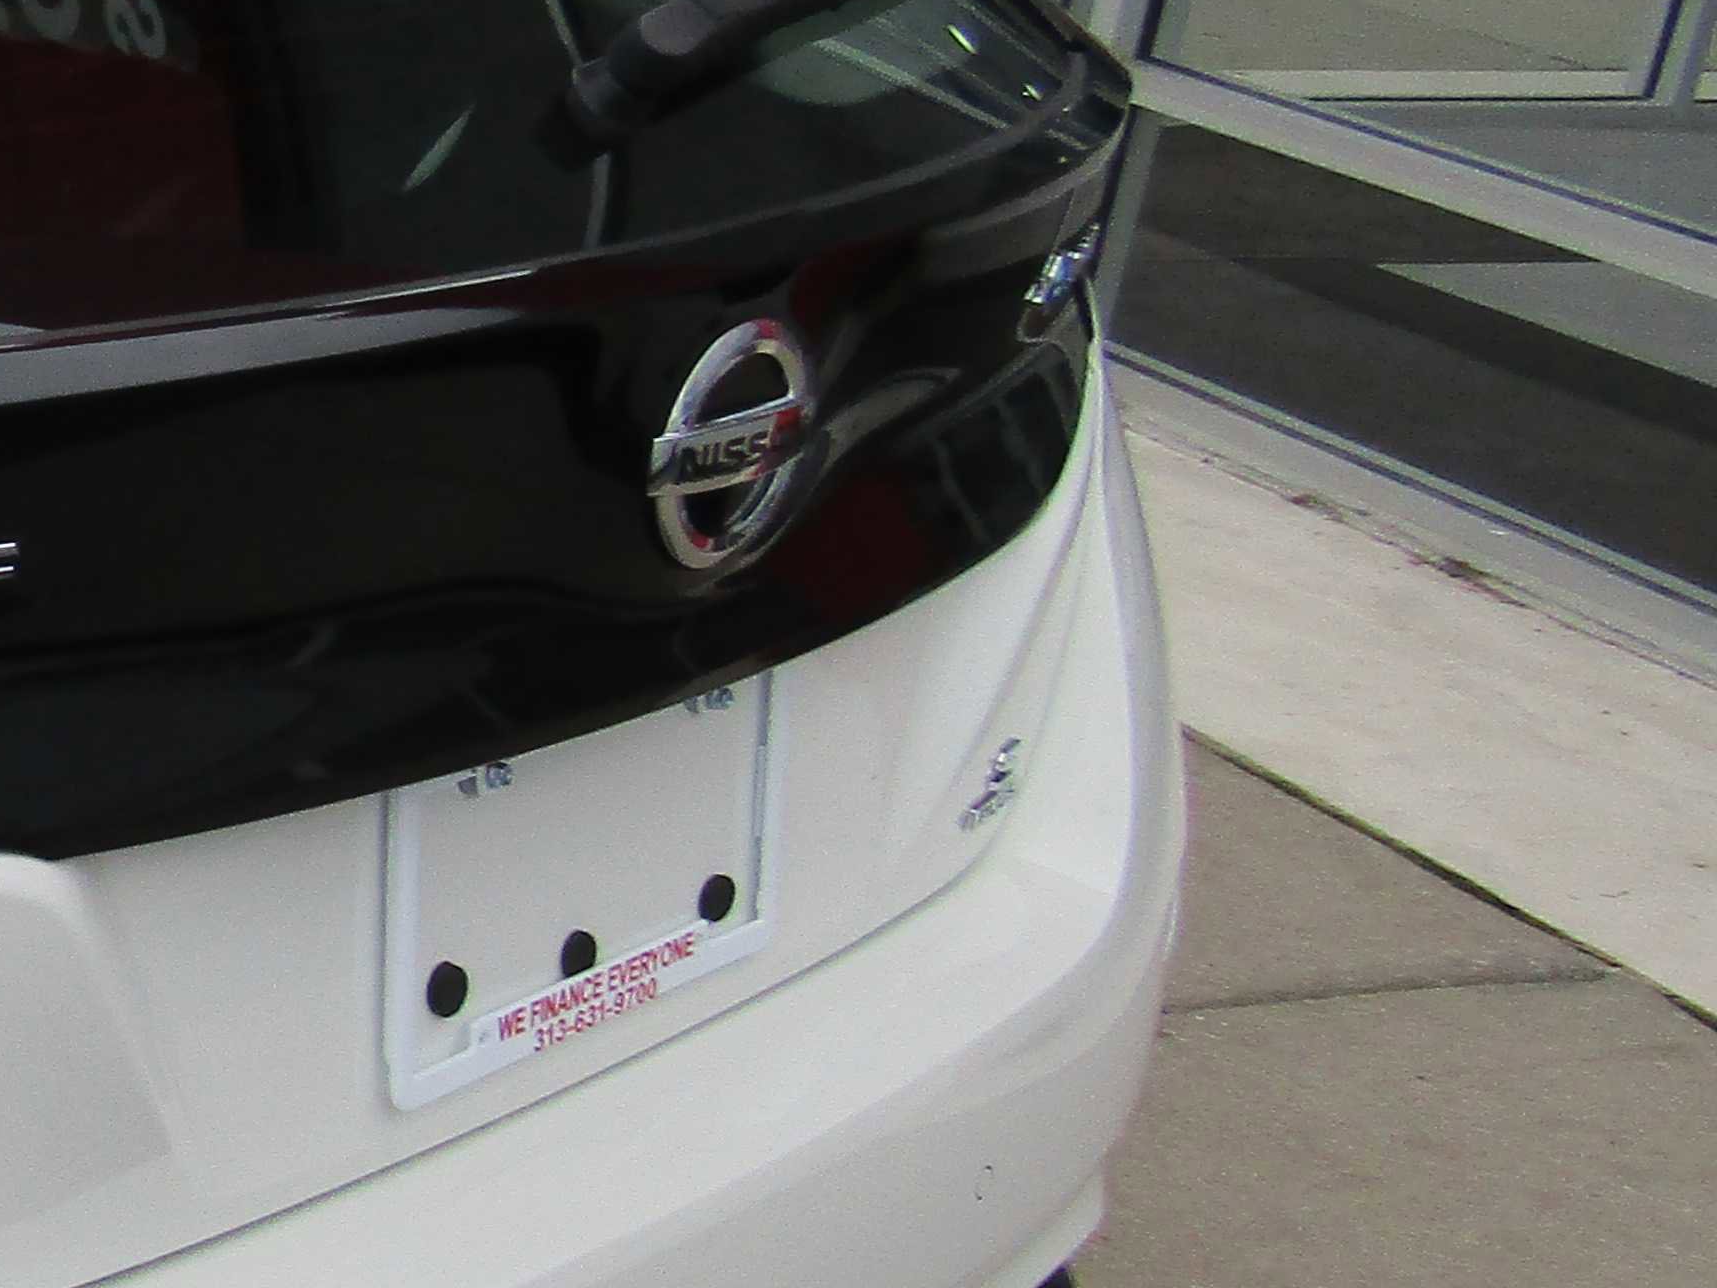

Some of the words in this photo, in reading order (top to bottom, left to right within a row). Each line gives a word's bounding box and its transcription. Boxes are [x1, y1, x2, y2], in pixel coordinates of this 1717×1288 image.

[497, 1006, 527, 1041] WE
[531, 972, 604, 1028] FINANCE
[608, 931, 695, 992] EVERYONE
[533, 977, 658, 1052] 313-631-9700
